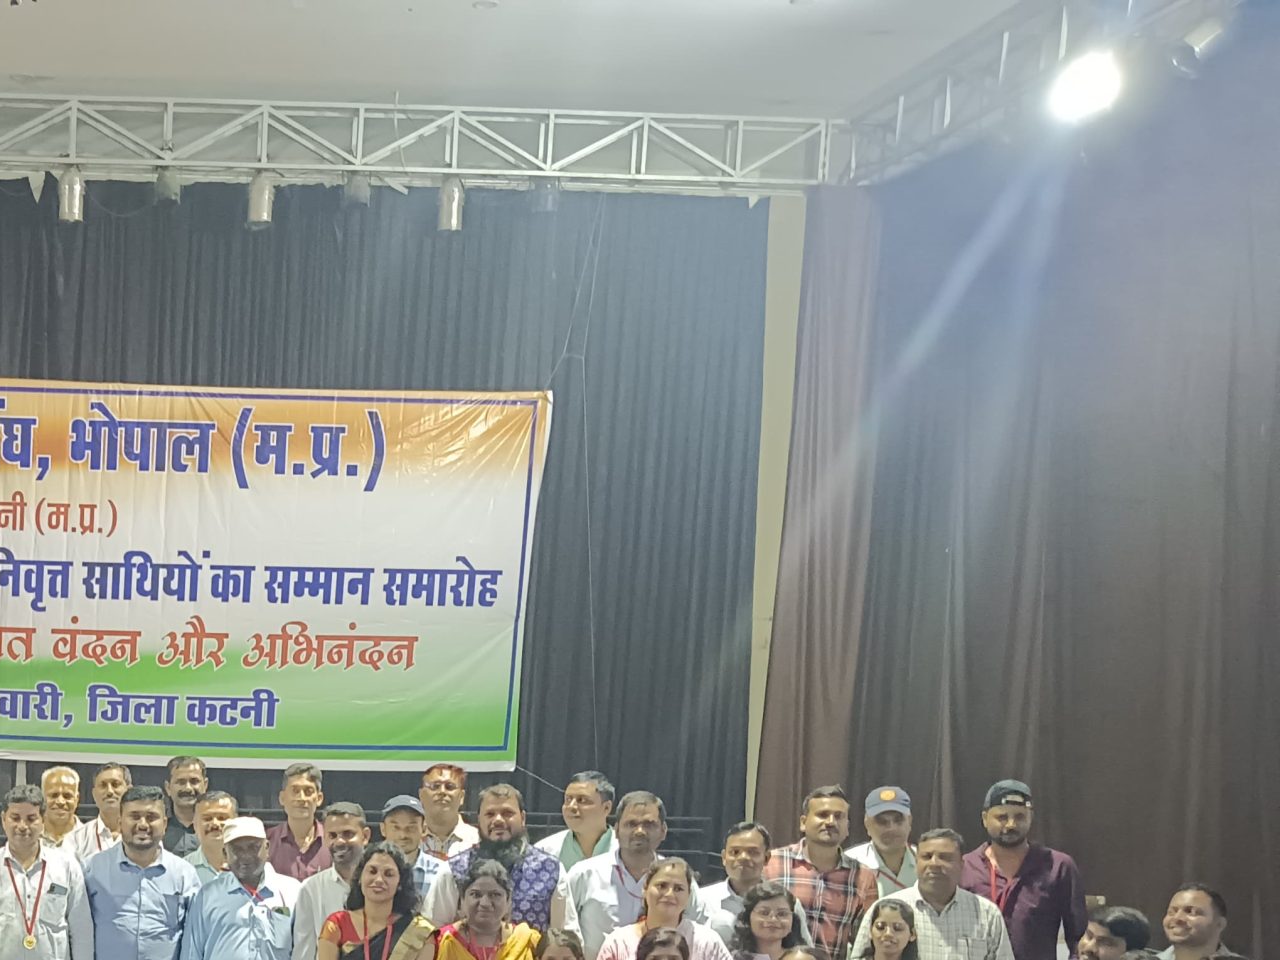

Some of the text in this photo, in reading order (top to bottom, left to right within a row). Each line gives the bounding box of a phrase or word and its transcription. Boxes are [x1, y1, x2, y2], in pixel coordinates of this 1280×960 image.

[69, 402, 215, 473] भोपाल
[232, 407, 386, 491] (म.प्र.)
[35, 498, 118, 537] (म.प्र.)
[82, 550, 216, 601] साथियों
[210, 565, 255, 602] का
[265, 566, 374, 606] सम्मान
[383, 557, 502, 608] समारोह
[51, 616, 141, 665] वंदन
[158, 615, 228, 668] और
[243, 622, 418, 671] अभिनंदन
[88, 684, 178, 725] जिला
[187, 689, 279, 727] कटनी
